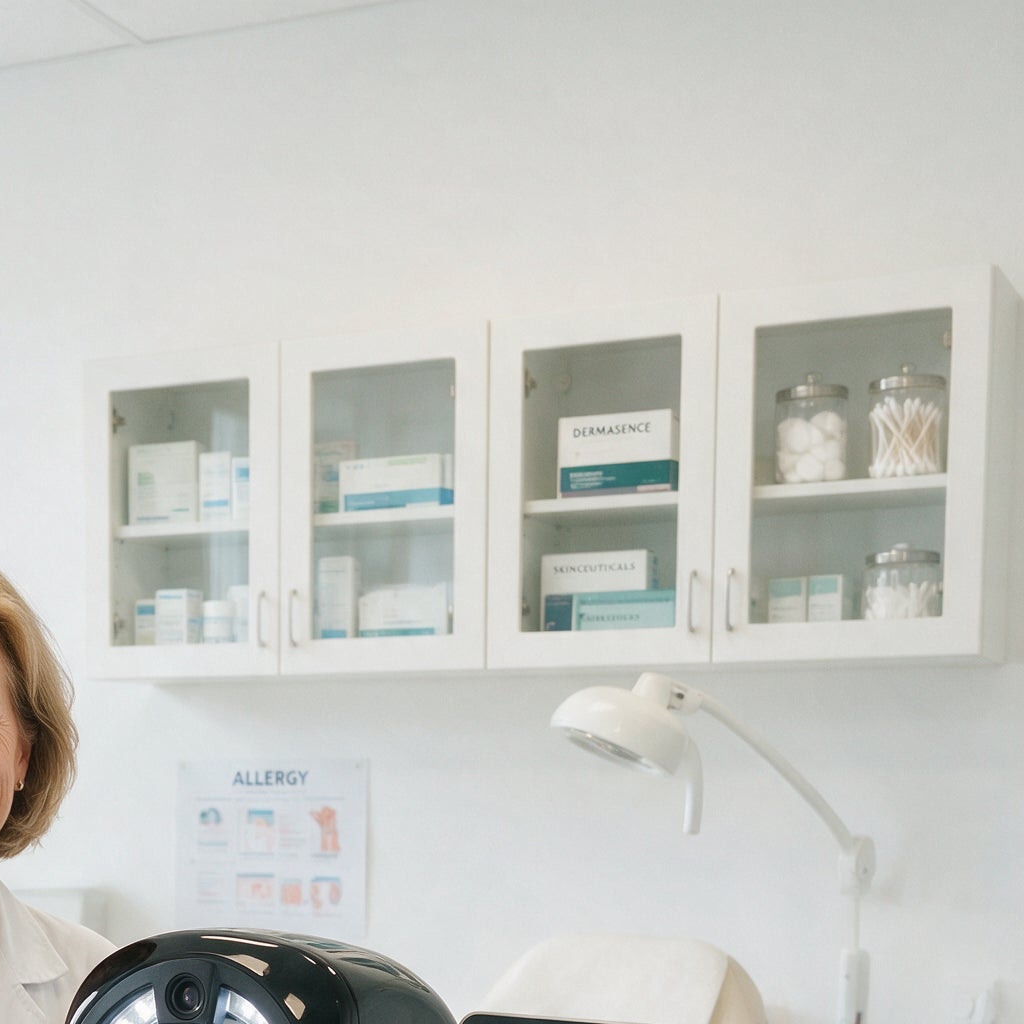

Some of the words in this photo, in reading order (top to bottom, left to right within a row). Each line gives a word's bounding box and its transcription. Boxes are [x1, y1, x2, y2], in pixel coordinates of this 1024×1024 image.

[573, 422, 651, 438] DERMASENCE
[553, 562, 636, 575] SKINCEUTICALS
[232, 770, 308, 786] ALLERGY
